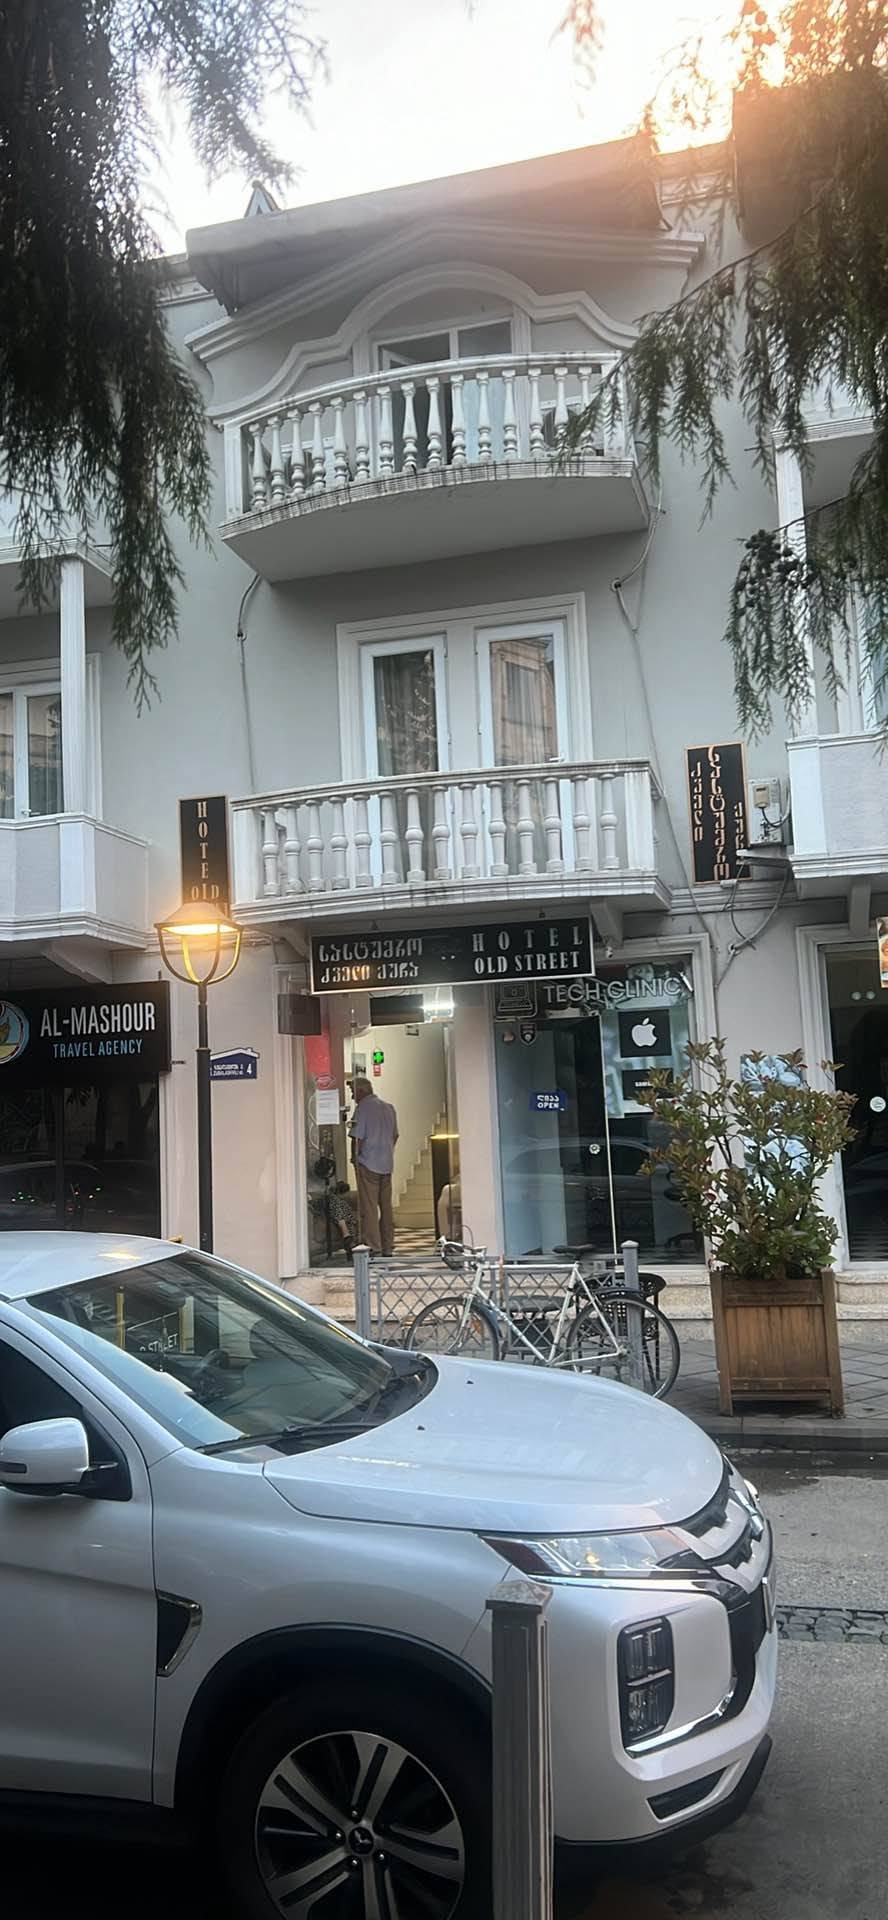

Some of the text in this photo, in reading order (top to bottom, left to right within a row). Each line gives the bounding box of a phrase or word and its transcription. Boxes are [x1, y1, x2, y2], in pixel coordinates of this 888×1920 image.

[690, 761, 703, 842] ძველი
[319, 937, 423, 962] სასტუმრო
[472, 925, 583, 953] HOTEL
[320, 961, 419, 983] ძველი ქუჩა
[474, 950, 580, 975] OLD STREET
[543, 976, 682, 1003] TECH CLINIC
[40, 1002, 156, 1038] AL-MASHOUR
[53, 1039, 143, 1059] TRAVEL AGENCY
[246, 1063, 252, 1075] 4
